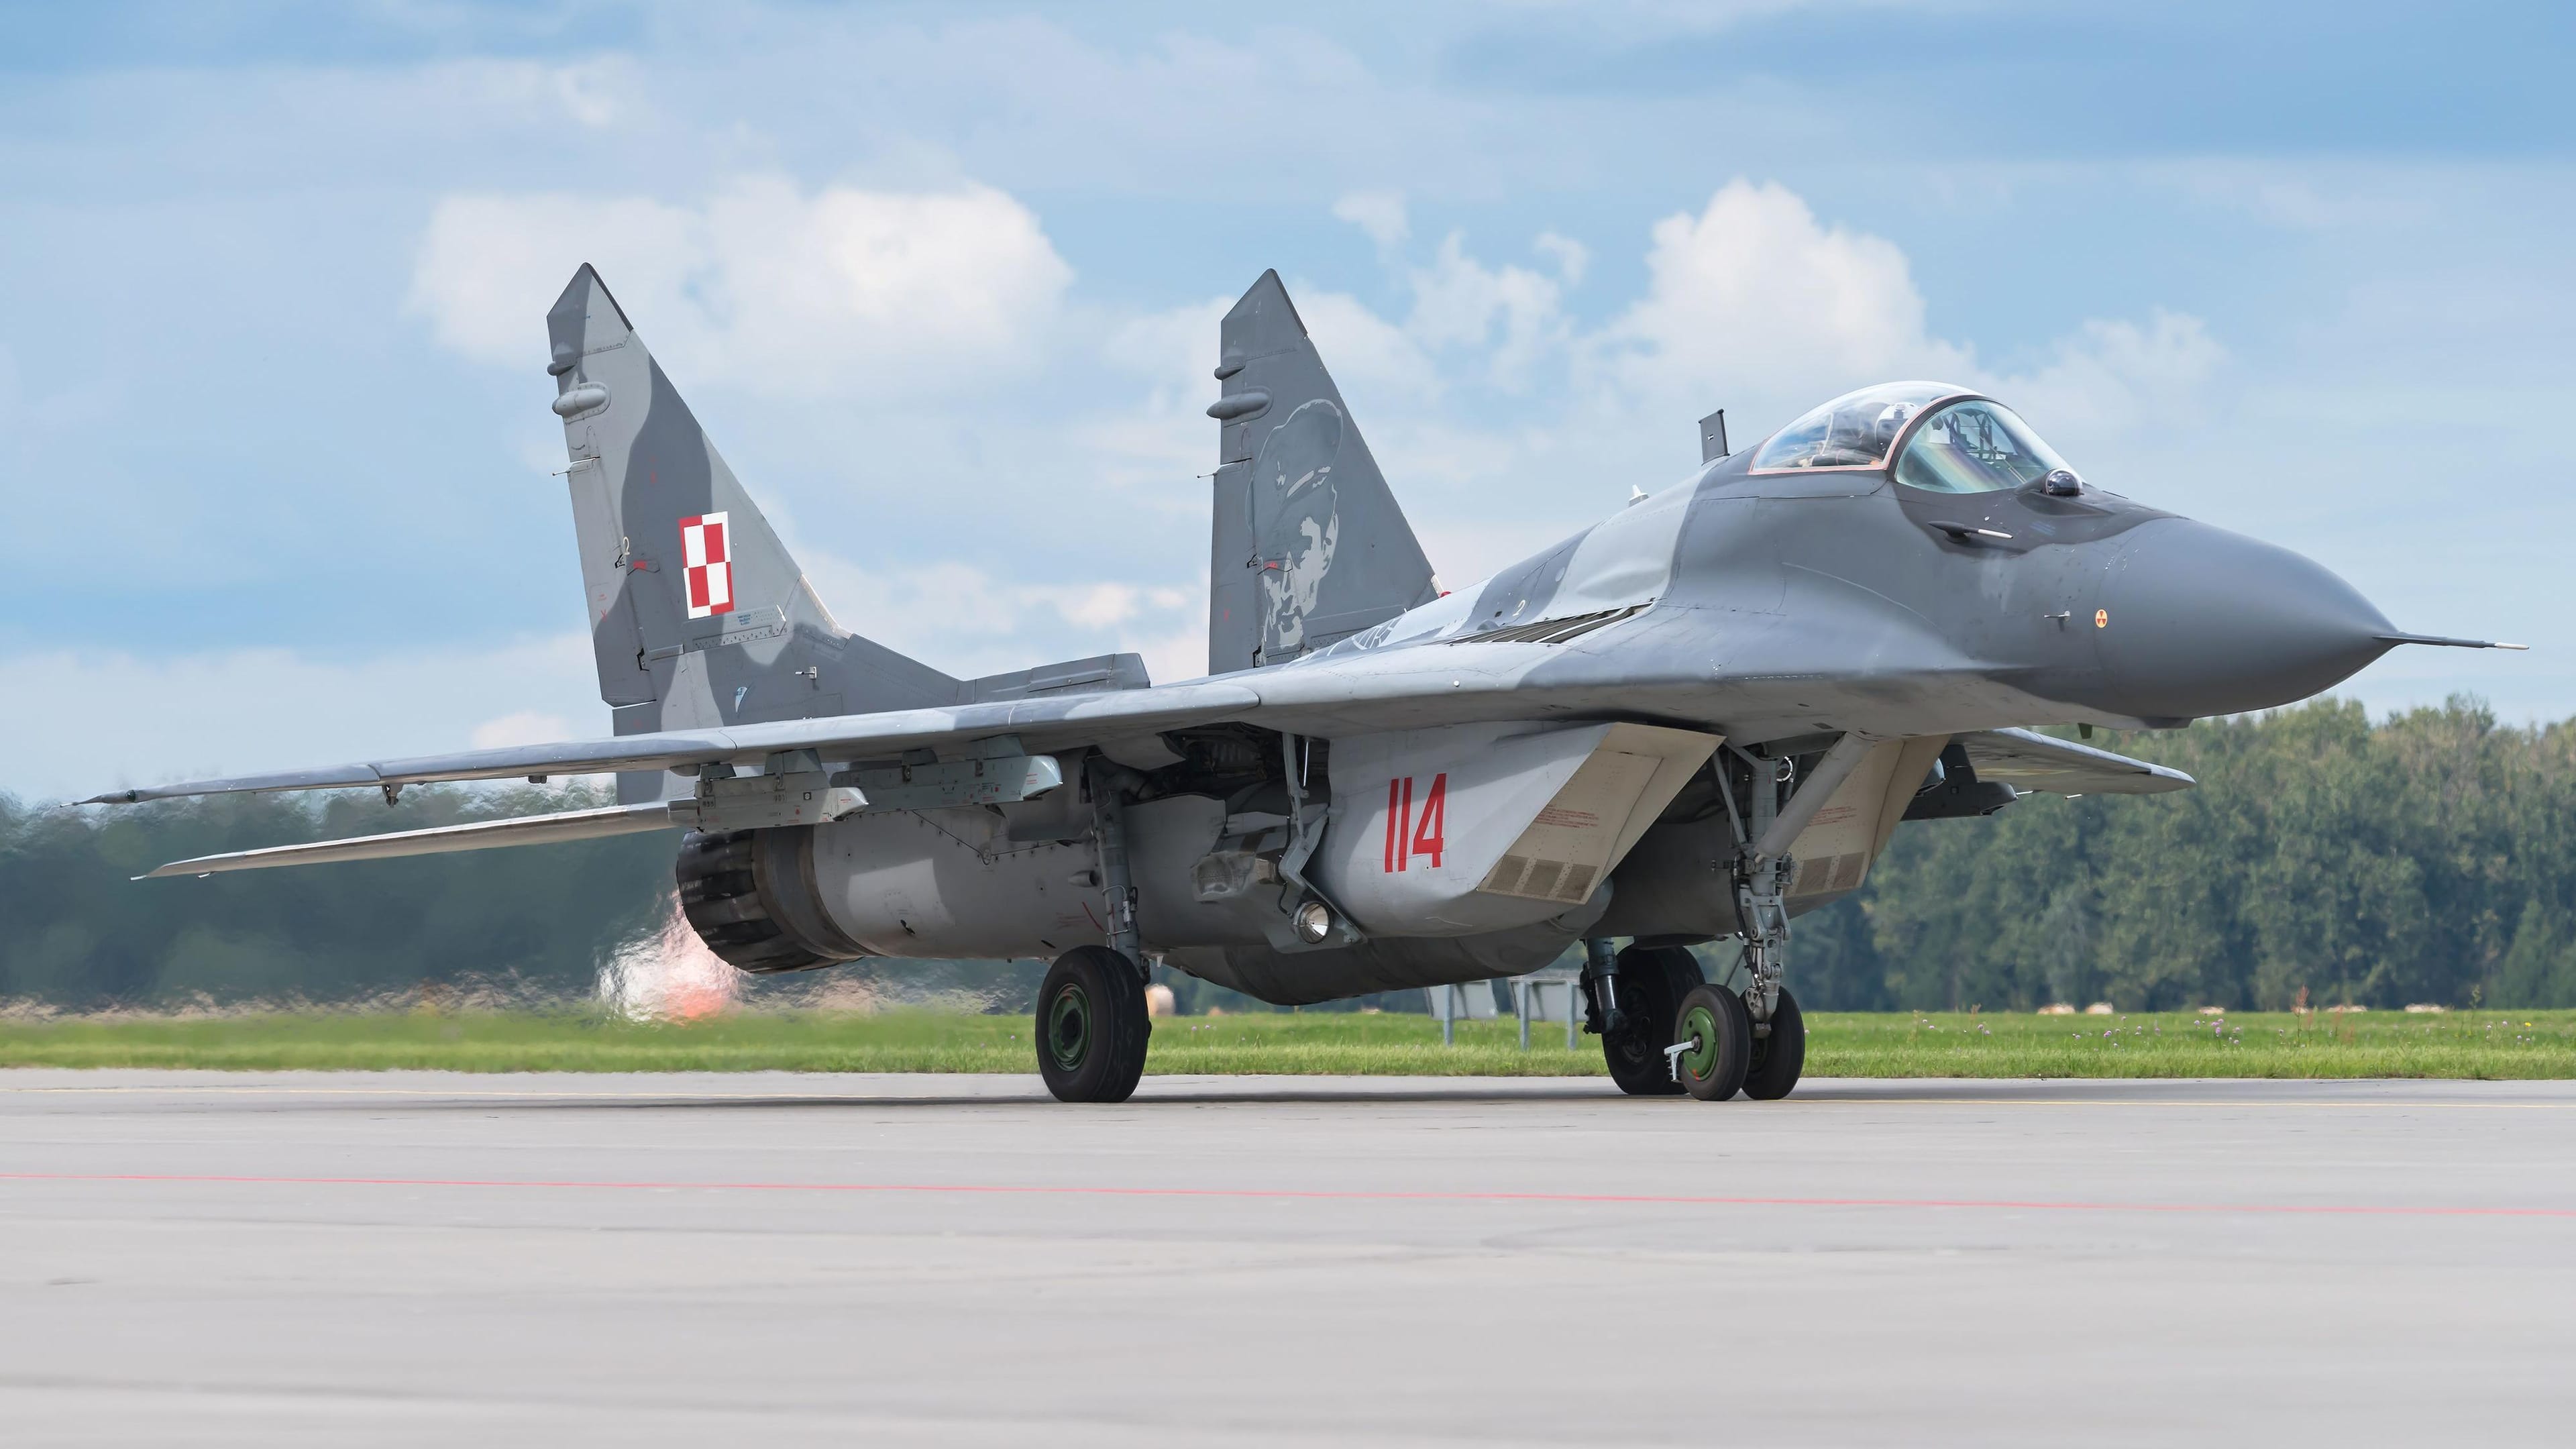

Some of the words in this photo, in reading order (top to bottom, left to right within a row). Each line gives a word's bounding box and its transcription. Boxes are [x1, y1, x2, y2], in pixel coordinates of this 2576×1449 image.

[623, 536, 631, 555] 2
[1512, 599, 1526, 617] 2
[1385, 773, 1447, 873] 114
